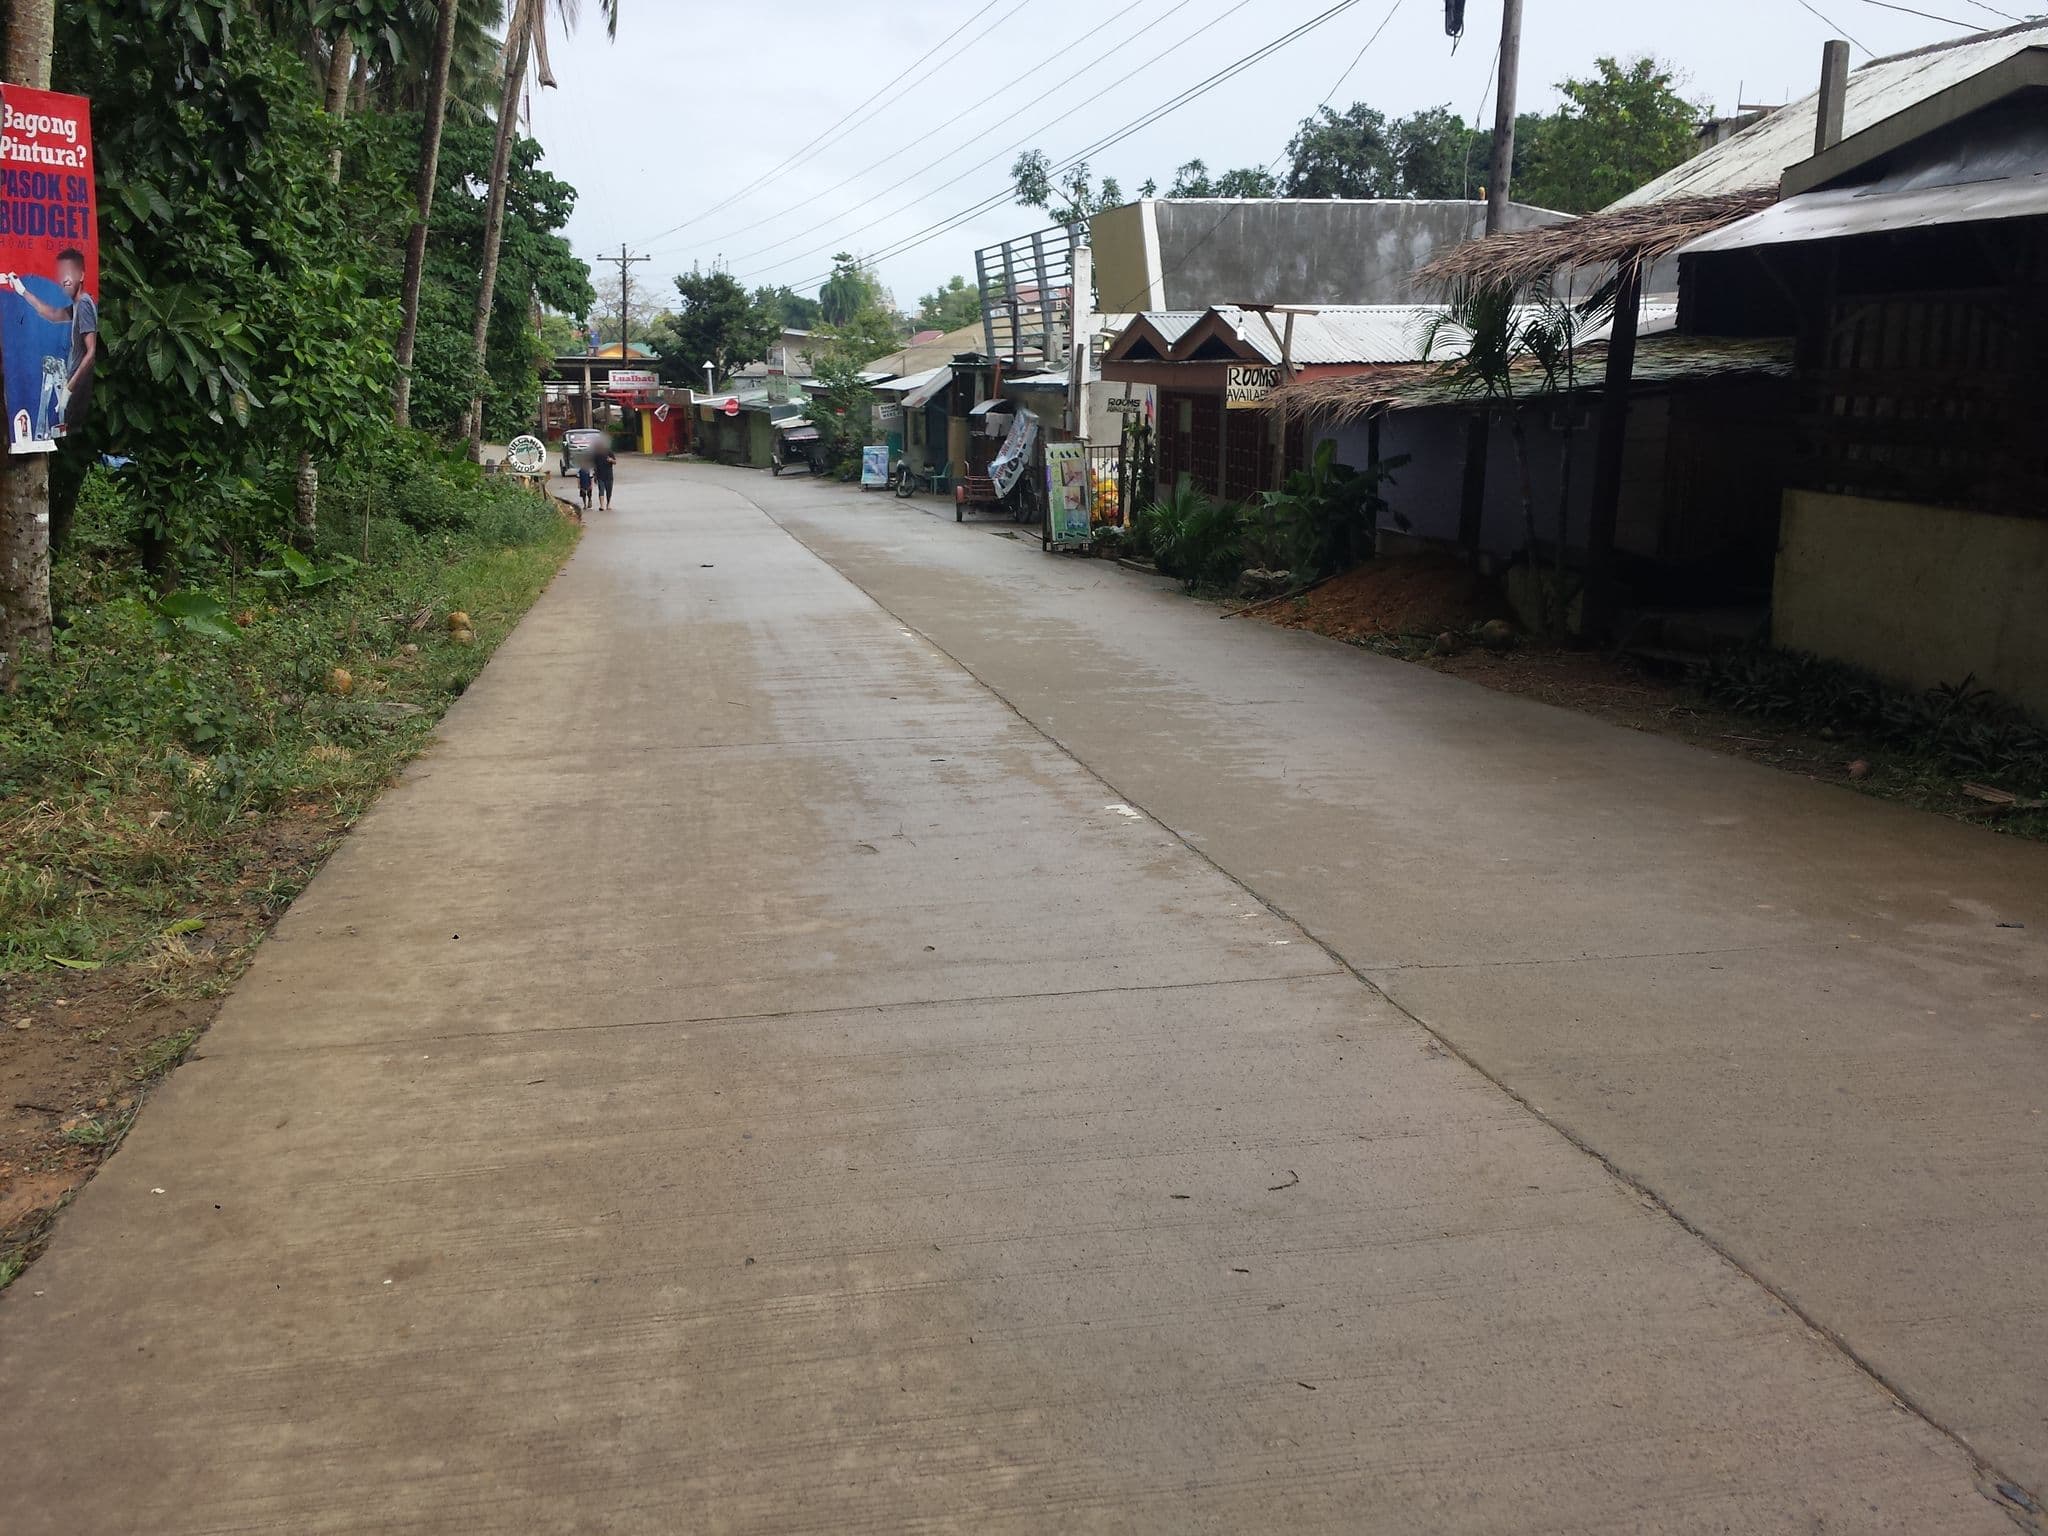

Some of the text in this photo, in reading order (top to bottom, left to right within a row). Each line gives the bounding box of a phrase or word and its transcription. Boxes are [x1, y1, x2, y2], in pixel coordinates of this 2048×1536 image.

[3, 104, 77, 143] Bagong
[0, 136, 87, 168] Pintura?
[0, 168, 89, 204] PASOK SA
[0, 200, 90, 239] BUDGET
[1228, 367, 1280, 387] ROOMS
[1108, 398, 1141, 407] ROOMS
[1227, 388, 1269, 402] AVAILAB
[508, 437, 544, 463] VULCANIZING
[512, 461, 535, 472] SHOP
